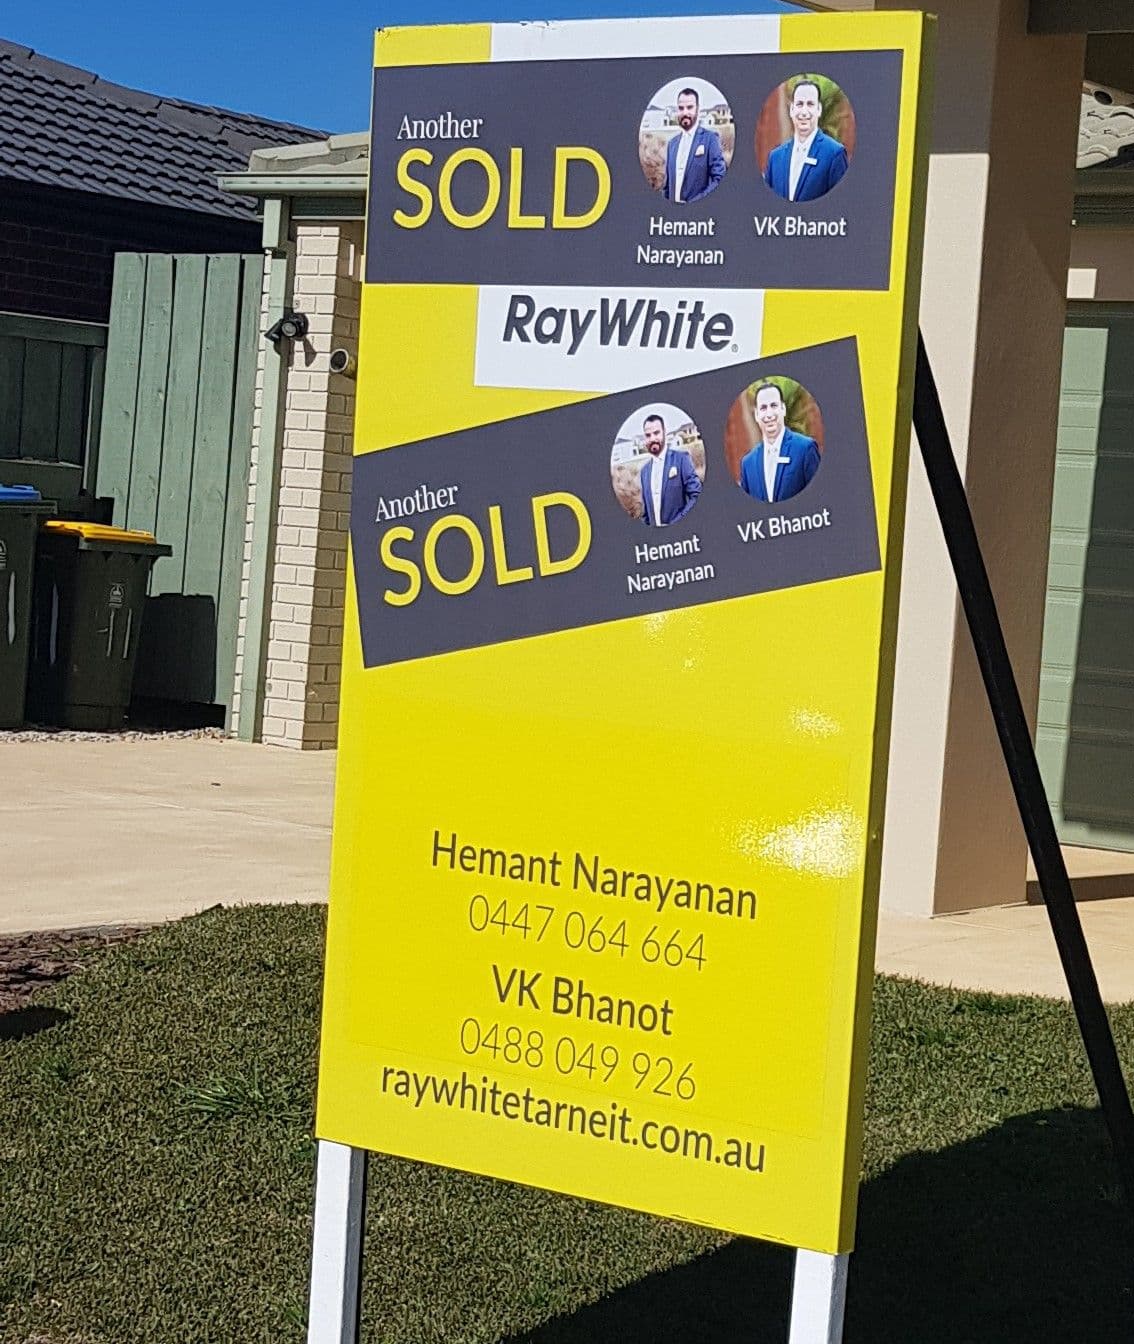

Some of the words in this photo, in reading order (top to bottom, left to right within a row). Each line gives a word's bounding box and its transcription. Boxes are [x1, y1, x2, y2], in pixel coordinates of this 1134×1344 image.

[396, 111, 483, 140] Another
[393, 146, 610, 229] SOLD
[649, 216, 716, 236] Hemant
[753, 216, 780, 236] VK
[784, 215, 847, 236] Bhanot
[637, 244, 724, 268] Narayanan
[375, 484, 459, 522] Another
[736, 519, 766, 543] VK
[768, 508, 831, 537] Bhanot
[380, 491, 592, 606] SOLD
[634, 534, 701, 564] Hemant
[627, 564, 715, 594] Narayanan
[432, 830, 563, 887] Hemant
[572, 852, 757, 920] Narayanan
[469, 894, 555, 942] 0447
[564, 911, 630, 958] 064
[641, 925, 707, 972] 664
[491, 964, 543, 1011] VK
[552, 975, 674, 1036] Bhanot
[460, 1017, 544, 1069] 0488
[555, 1036, 619, 1083] 049
[632, 1052, 696, 1101] 926
[381, 1066, 765, 1173] raywhitetarneit.com.au
